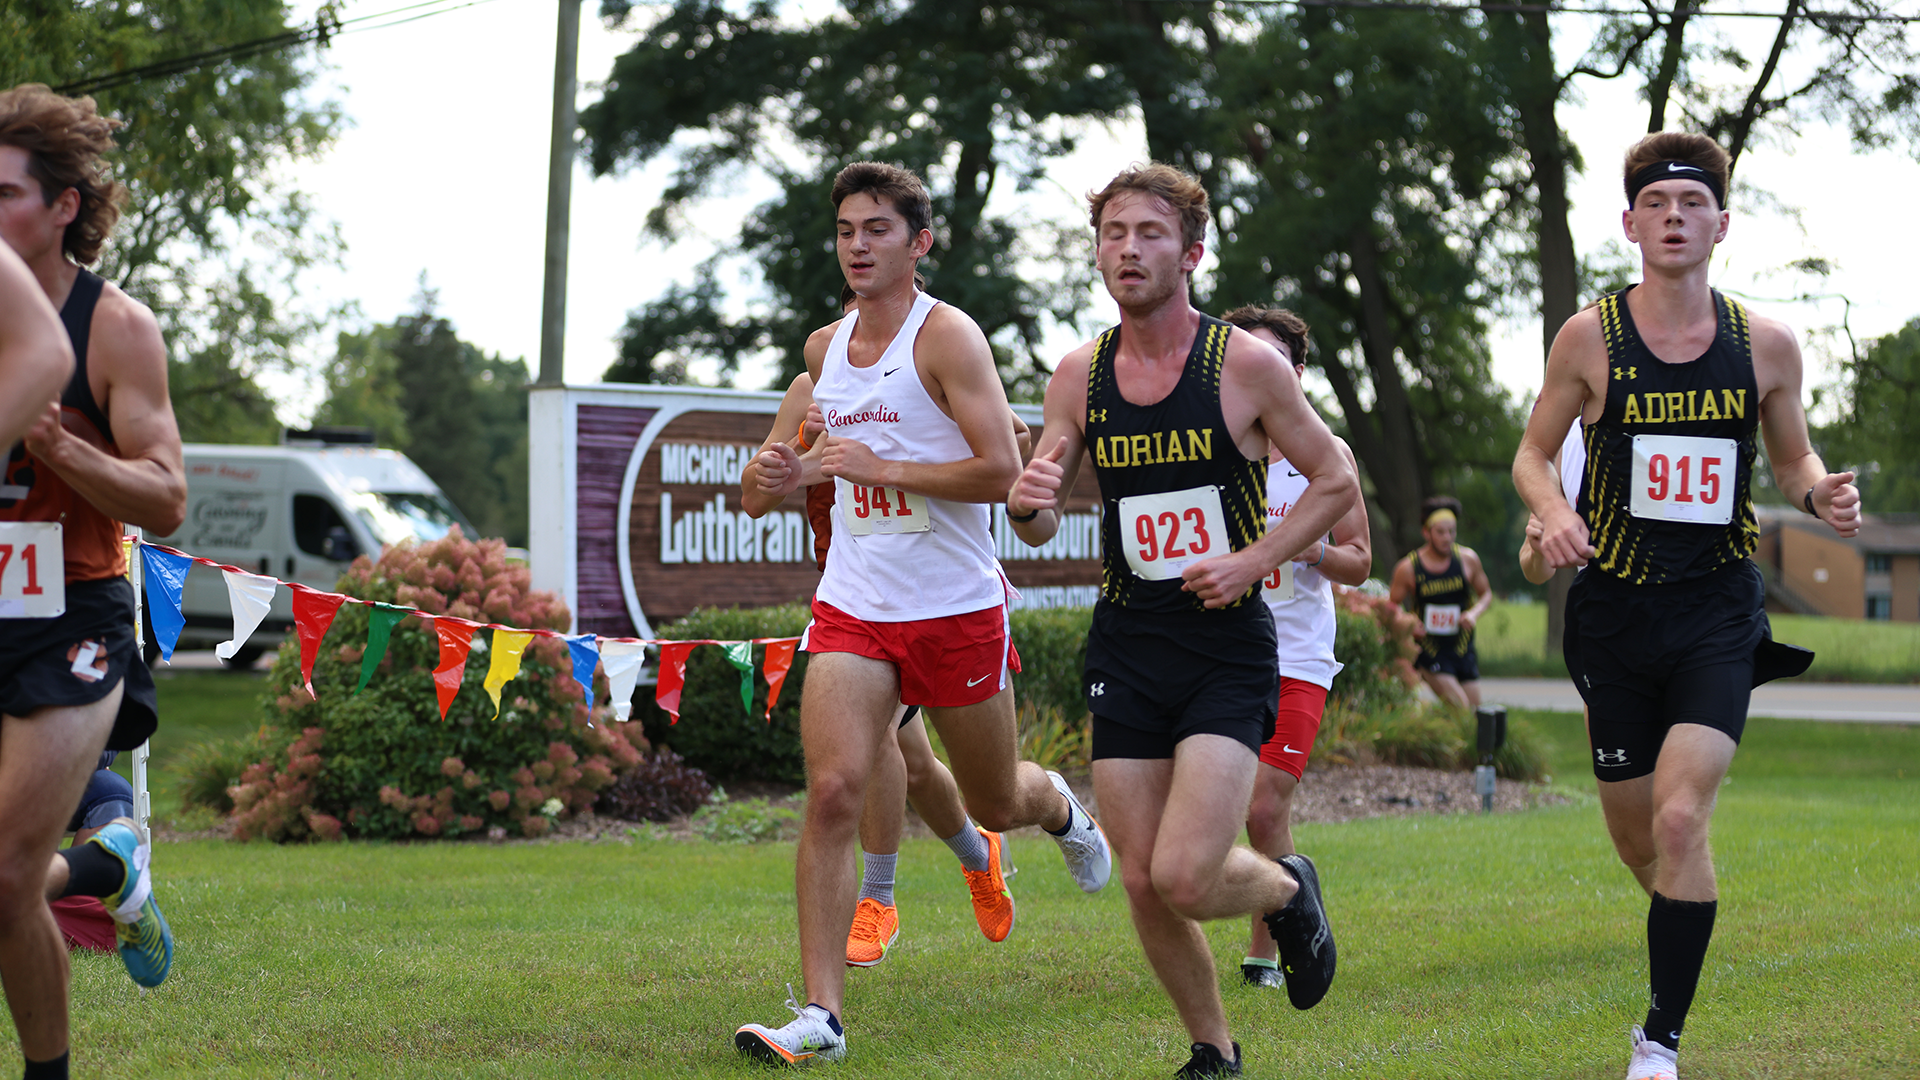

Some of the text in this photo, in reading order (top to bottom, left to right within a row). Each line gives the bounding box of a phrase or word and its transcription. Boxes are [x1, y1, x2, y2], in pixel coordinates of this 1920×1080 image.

[828, 404, 901, 428] Concordia
[1623, 389, 1746, 423] ADRIAN
[660, 443, 758, 485] MICHIGA
[1096, 428, 1213, 468] ADRIAN
[1648, 453, 1721, 504] 915
[853, 484, 912, 518] 941
[660, 492, 803, 563] Lutheran
[1136, 507, 1211, 562] 923
